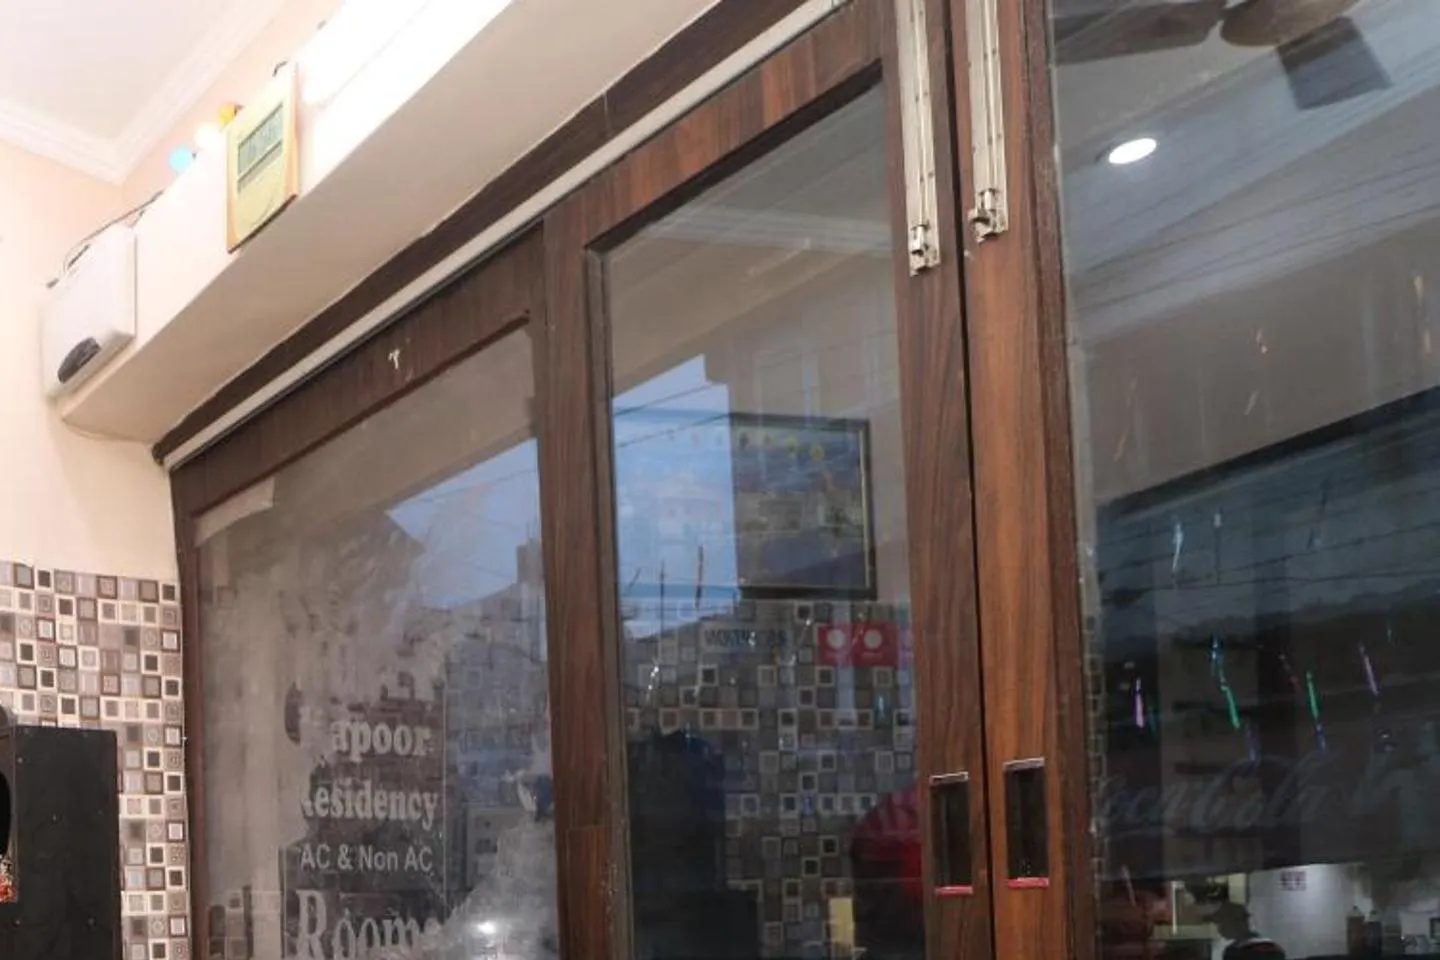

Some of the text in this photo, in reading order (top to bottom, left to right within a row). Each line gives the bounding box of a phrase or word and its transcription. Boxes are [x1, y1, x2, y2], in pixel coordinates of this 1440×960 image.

[300, 843, 434, 873] AC & Non AC
